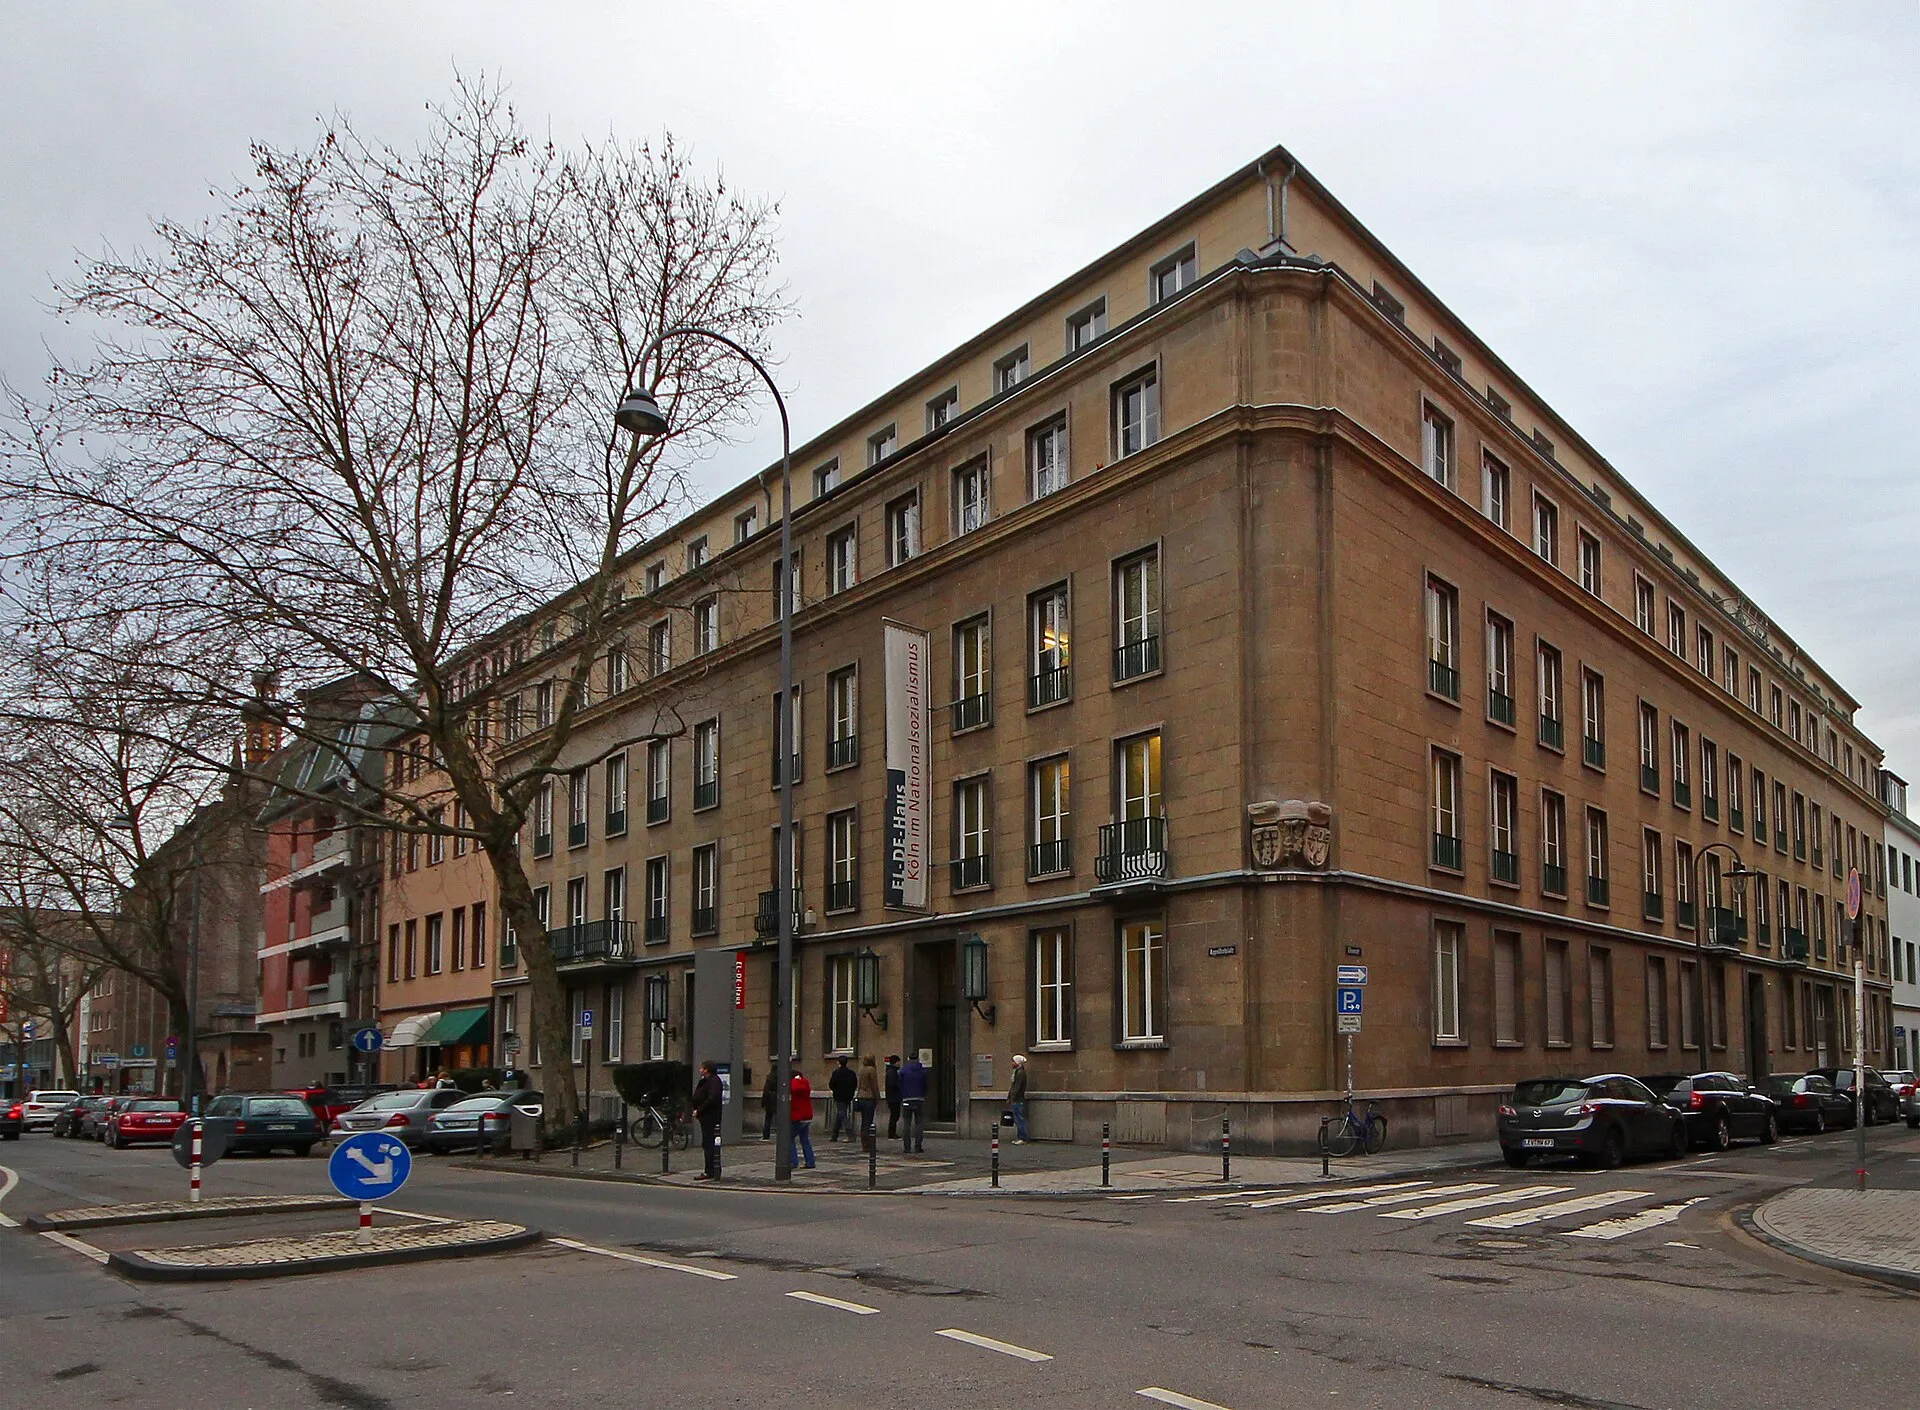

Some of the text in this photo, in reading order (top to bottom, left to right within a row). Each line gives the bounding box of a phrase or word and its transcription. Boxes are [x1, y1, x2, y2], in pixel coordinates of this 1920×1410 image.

[906, 643, 920, 881] Köln im Nationalsozialismus
[891, 784, 906, 890] EL-DE-Haus
[584, 1012, 591, 1025] P
[1343, 991, 1357, 1010] P
